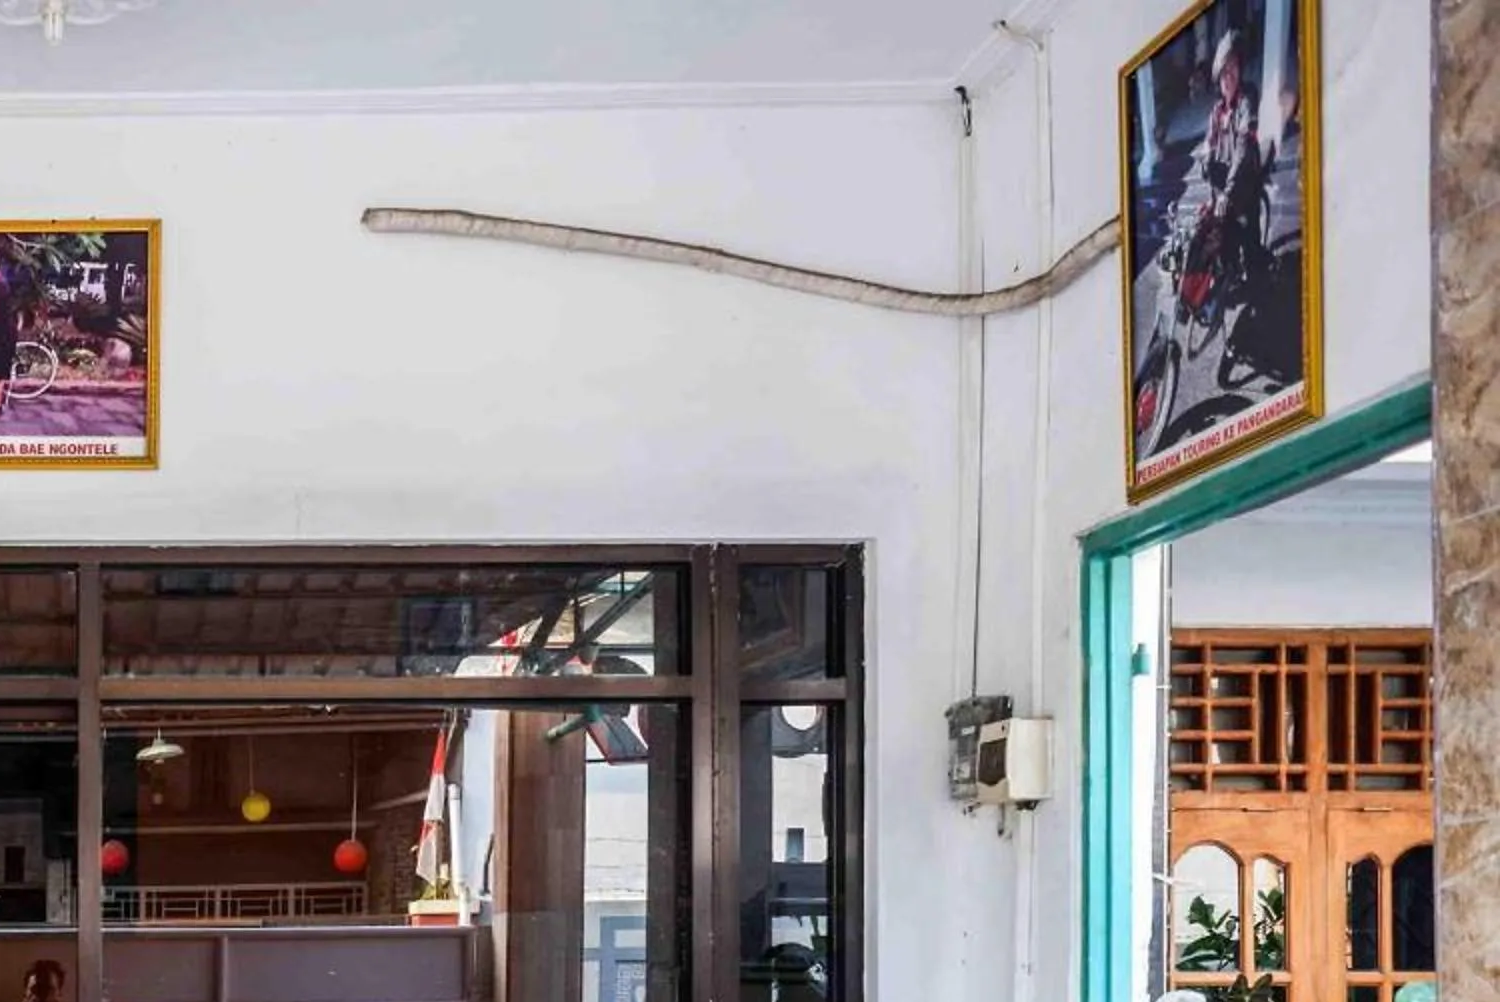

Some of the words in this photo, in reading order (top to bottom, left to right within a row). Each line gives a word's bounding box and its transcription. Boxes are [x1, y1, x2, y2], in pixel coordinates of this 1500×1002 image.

[1224, 425, 1236, 443] KE
[19, 442, 45, 455] BAE
[49, 442, 119, 455] NGONTELE
